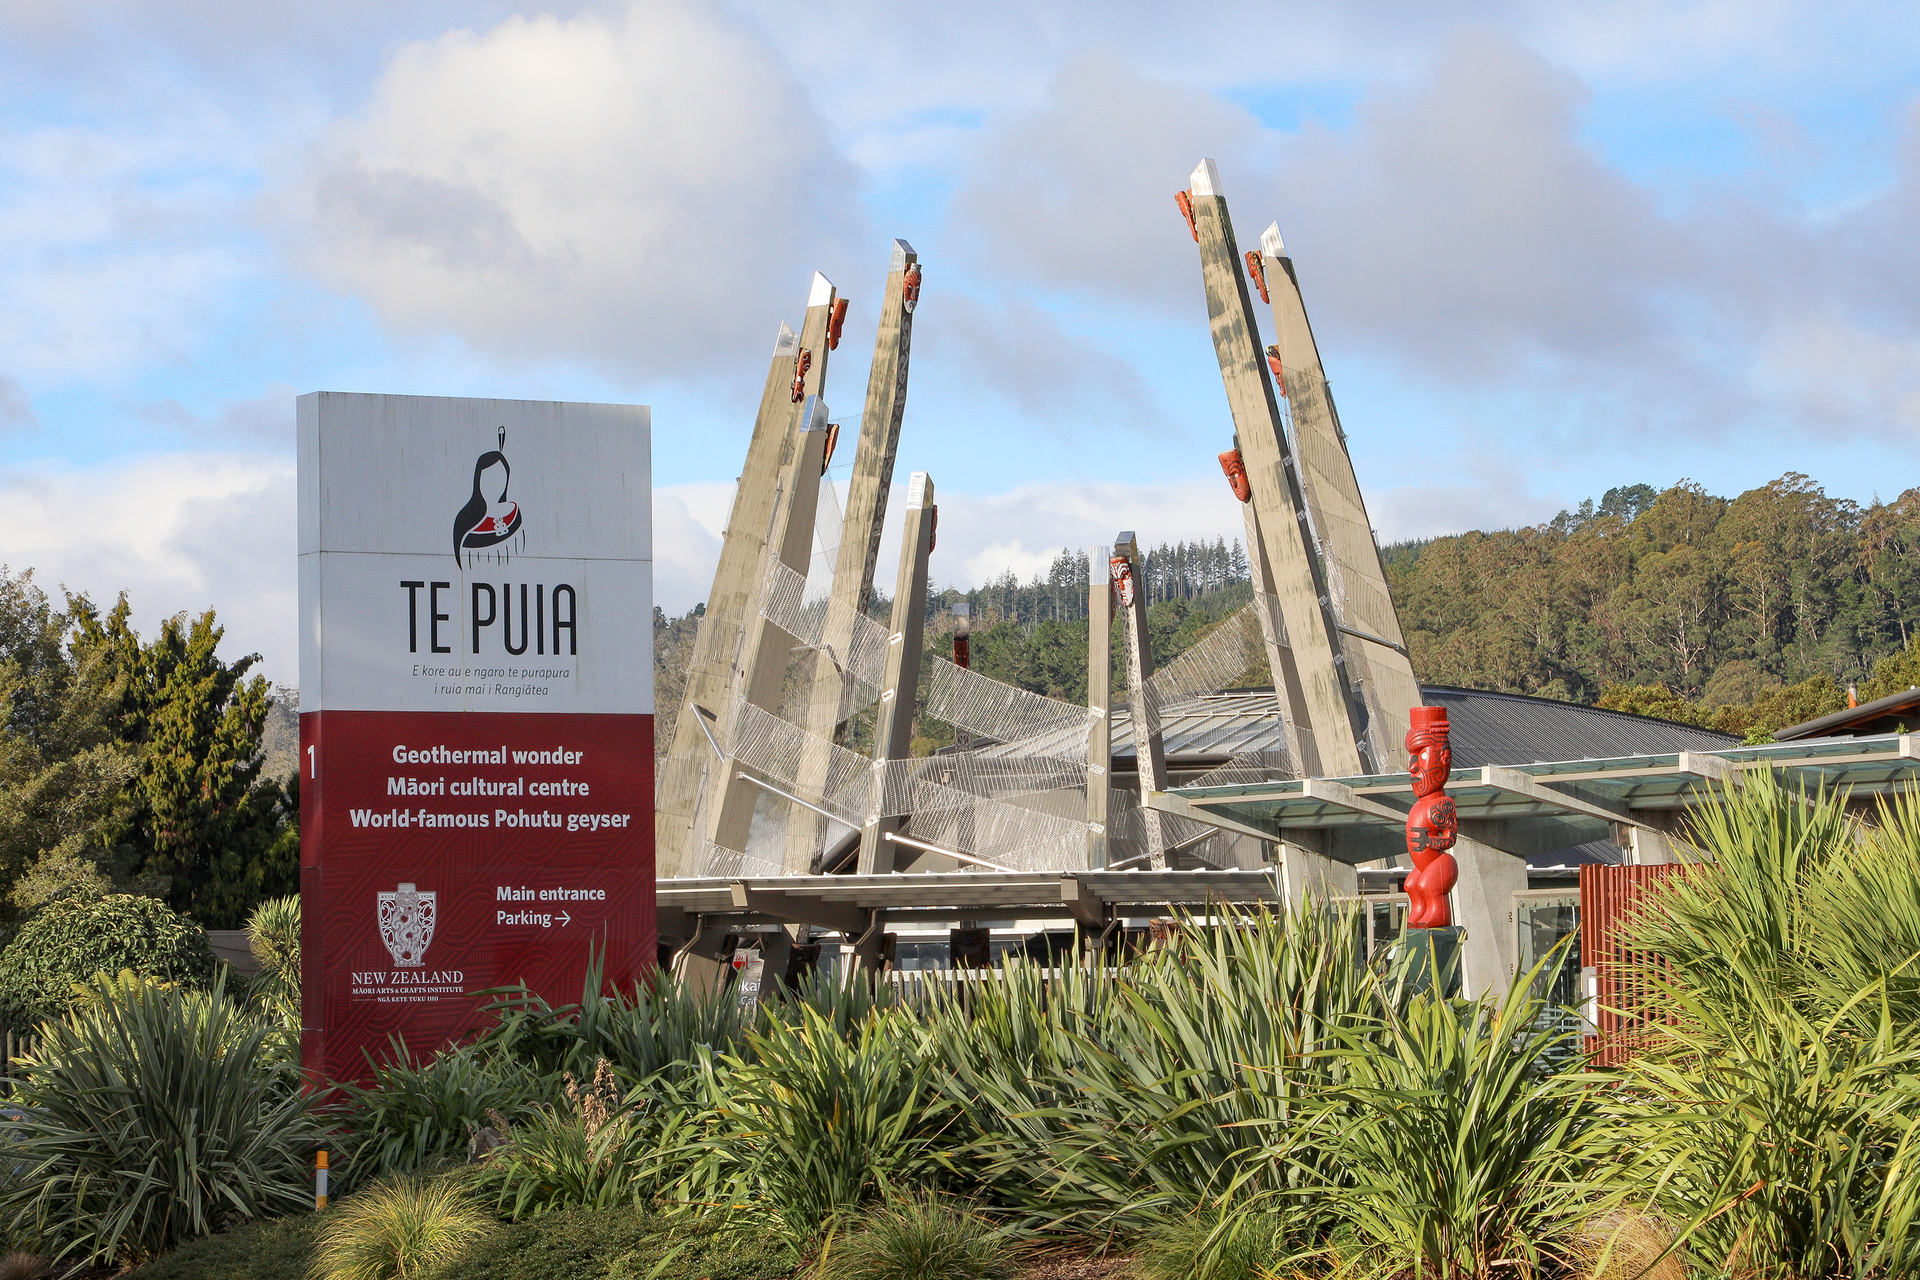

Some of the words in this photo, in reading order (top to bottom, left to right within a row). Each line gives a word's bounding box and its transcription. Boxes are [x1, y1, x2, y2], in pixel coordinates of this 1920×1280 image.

[400, 580, 450, 653] TE
[472, 582, 577, 656] PUIA
[412, 664, 420, 677] E
[422, 664, 445, 677] kore
[448, 667, 462, 677] au
[464, 668, 471, 677] e
[474, 667, 505, 680] ngaro
[508, 666, 519, 678] te
[521, 668, 570, 680] purapura
[434, 682, 438, 694] i
[440, 683, 462, 695] ruia
[465, 683, 485, 695] mai
[488, 683, 492, 695] i
[494, 683, 549, 698] Rangiātea
[307, 744, 316, 779] 1
[392, 744, 507, 765] Geothermal
[512, 745, 584, 765] wonder
[387, 776, 445, 796] Māori
[449, 776, 524, 796] cultural
[528, 778, 590, 796] centre
[350, 808, 490, 828] World-famous
[494, 808, 562, 828] Pohutu
[566, 812, 631, 832] geyser
[496, 885, 536, 901] Main
[539, 886, 606, 901] entrance
[497, 909, 552, 928] Parking
[352, 971, 387, 985] NEW
[391, 970, 464, 985] ZEALAND
[352, 986, 375, 995] MĀORI
[399, 986, 427, 994] CRAFTS
